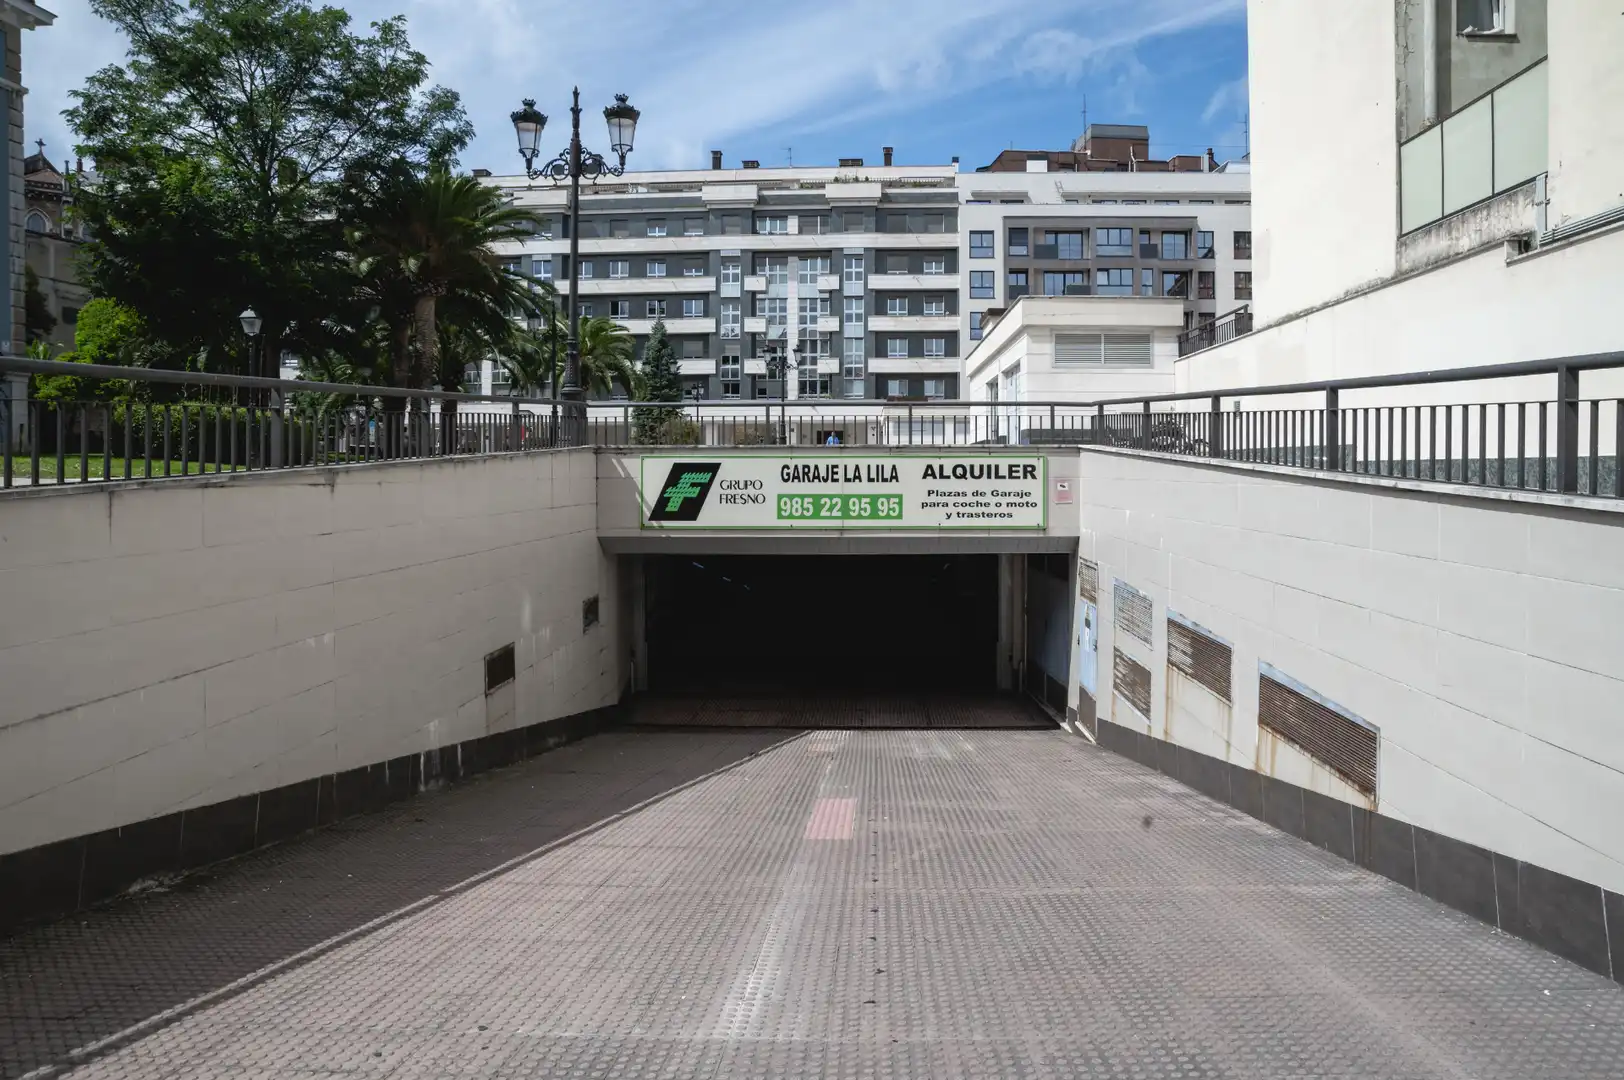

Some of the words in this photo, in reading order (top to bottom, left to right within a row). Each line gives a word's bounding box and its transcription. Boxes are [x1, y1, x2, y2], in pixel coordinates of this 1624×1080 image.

[781, 464, 840, 483] GARAJE
[843, 464, 863, 483] LA
[866, 464, 900, 483] LILA
[921, 463, 1038, 481] ALQUILER
[719, 479, 764, 491] GRUPO
[719, 493, 766, 505] FRESNO
[927, 489, 968, 498] Plazas
[971, 489, 987, 498] de
[990, 489, 1032, 499] Garaje
[780, 497, 814, 517] 985
[819, 497, 842, 517] 22
[848, 497, 871, 517] 95
[877, 497, 900, 517] 95
[921, 501, 949, 510] para
[952, 500, 991, 508] coche
[1006, 500, 1038, 508] moto
[945, 512, 953, 520] y
[956, 511, 1014, 519] trasteros
